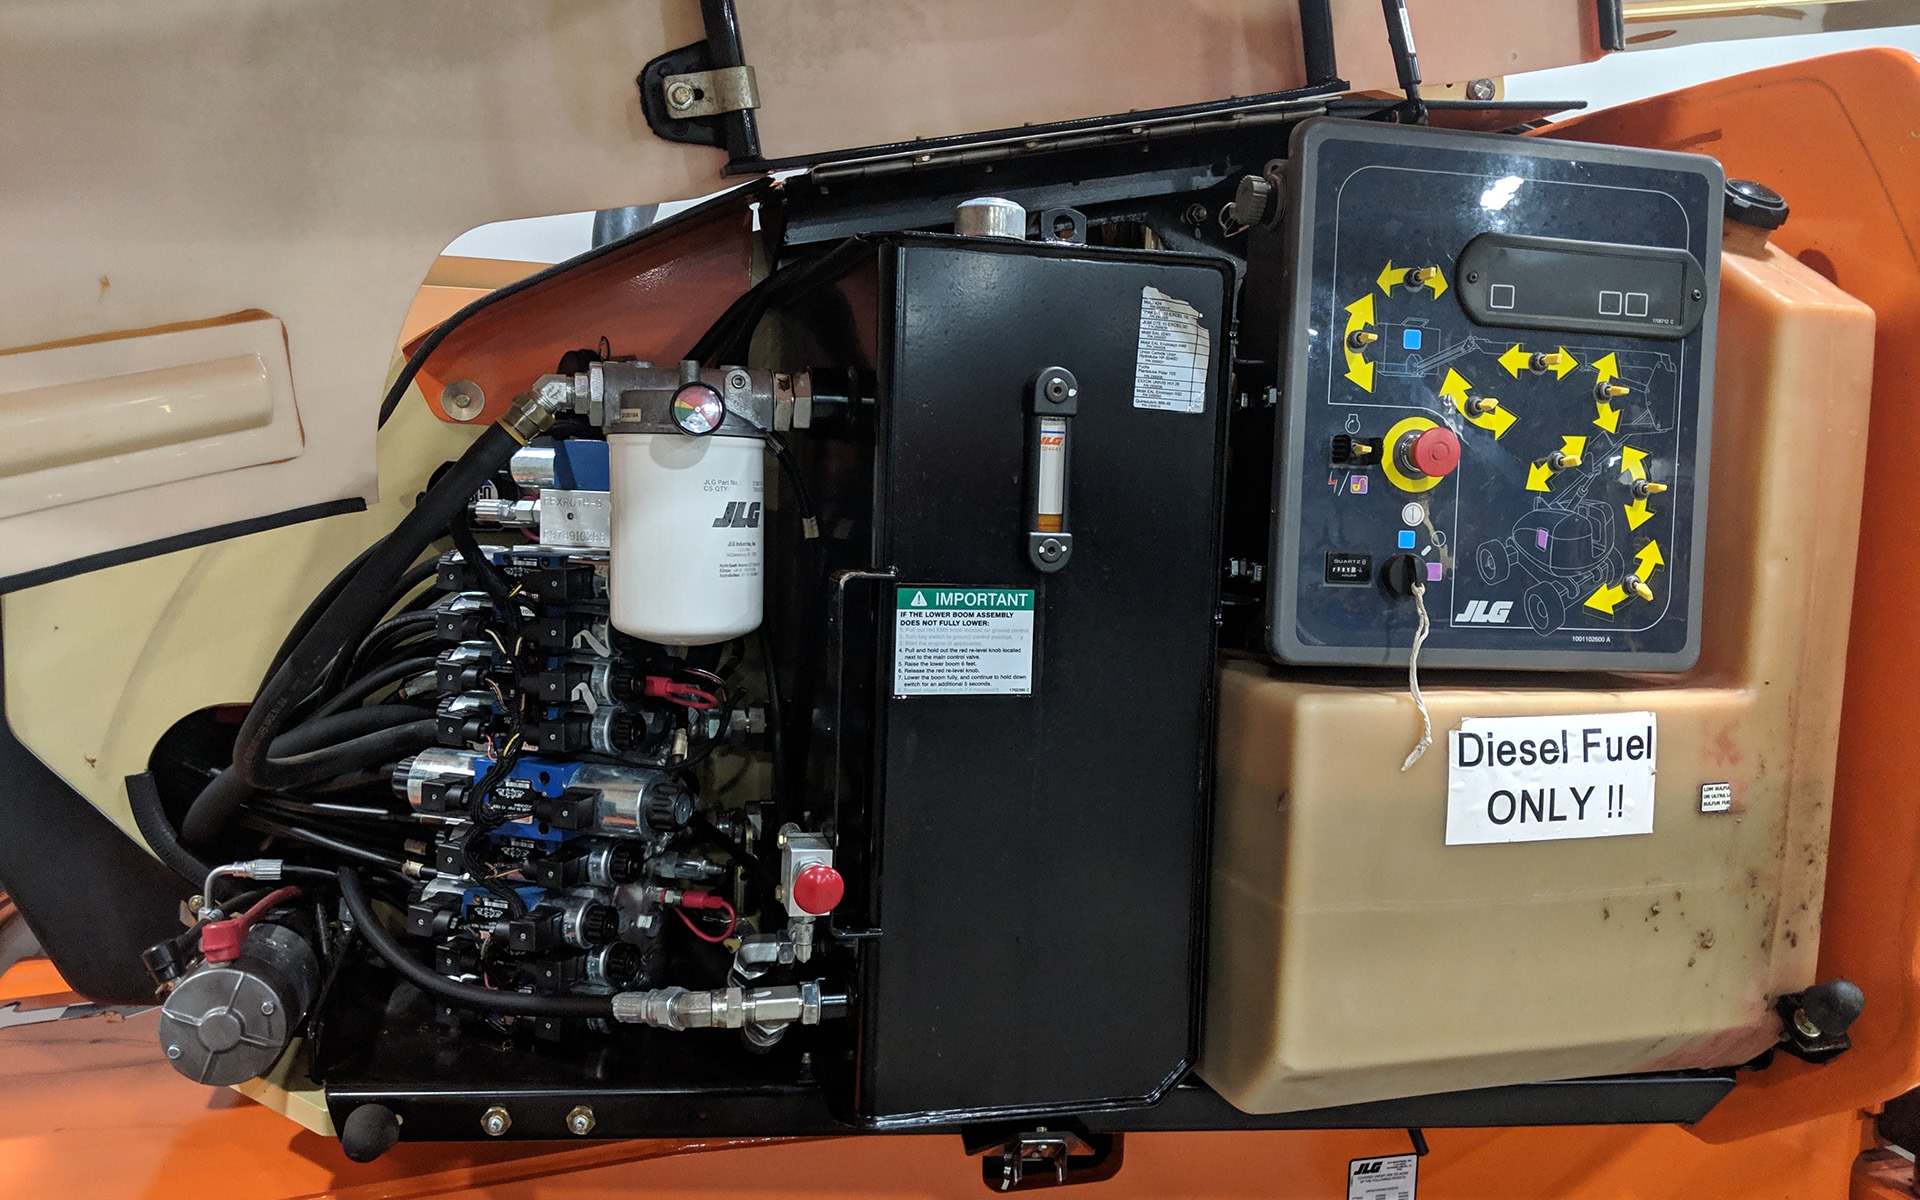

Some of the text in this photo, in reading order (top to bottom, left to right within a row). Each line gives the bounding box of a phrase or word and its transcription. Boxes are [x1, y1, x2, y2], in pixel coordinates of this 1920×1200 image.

[712, 502, 761, 527] JLG
[936, 592, 1028, 606] IMPORTANT
[1454, 600, 1514, 623] JLG
[1459, 726, 1652, 767] Diesel Fuel
[1487, 784, 1624, 825] ONLY !!
[1354, 1161, 1383, 1175] JLG
